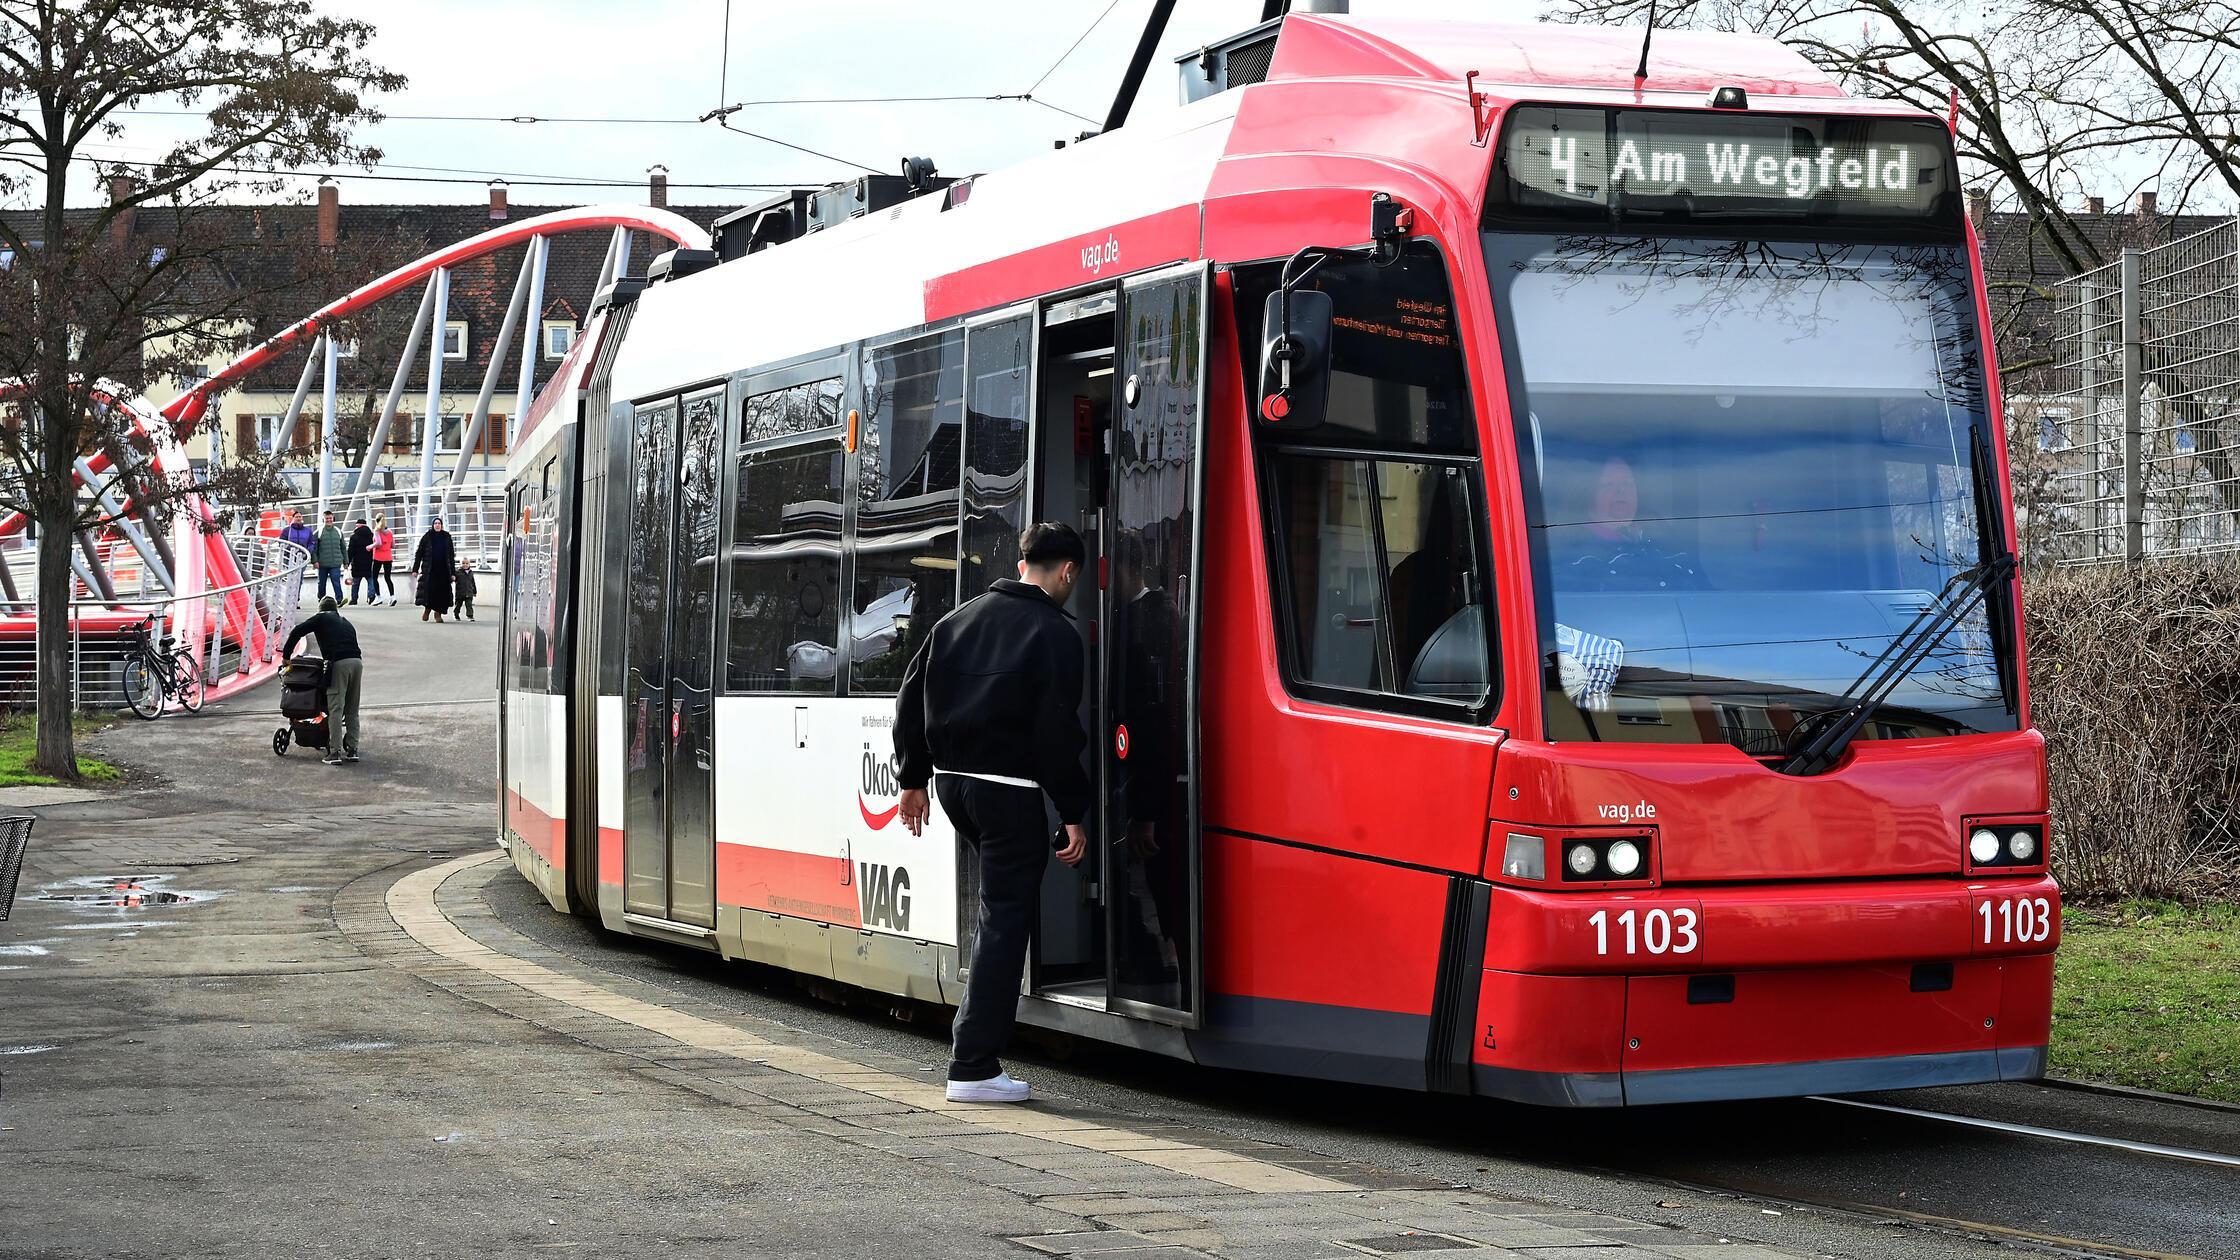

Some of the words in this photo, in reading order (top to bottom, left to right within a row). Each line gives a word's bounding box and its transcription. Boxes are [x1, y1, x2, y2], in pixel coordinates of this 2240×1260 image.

[1551, 137, 1576, 193] 4
[1611, 139, 1685, 182] Am
[1706, 143, 1908, 197] Wegfeld
[1081, 233, 1119, 274] vag.de
[1598, 800, 1656, 823] vag.de
[860, 862, 911, 932] VAG
[1588, 908, 1699, 955] 1103
[1978, 898, 2050, 944] 1103
